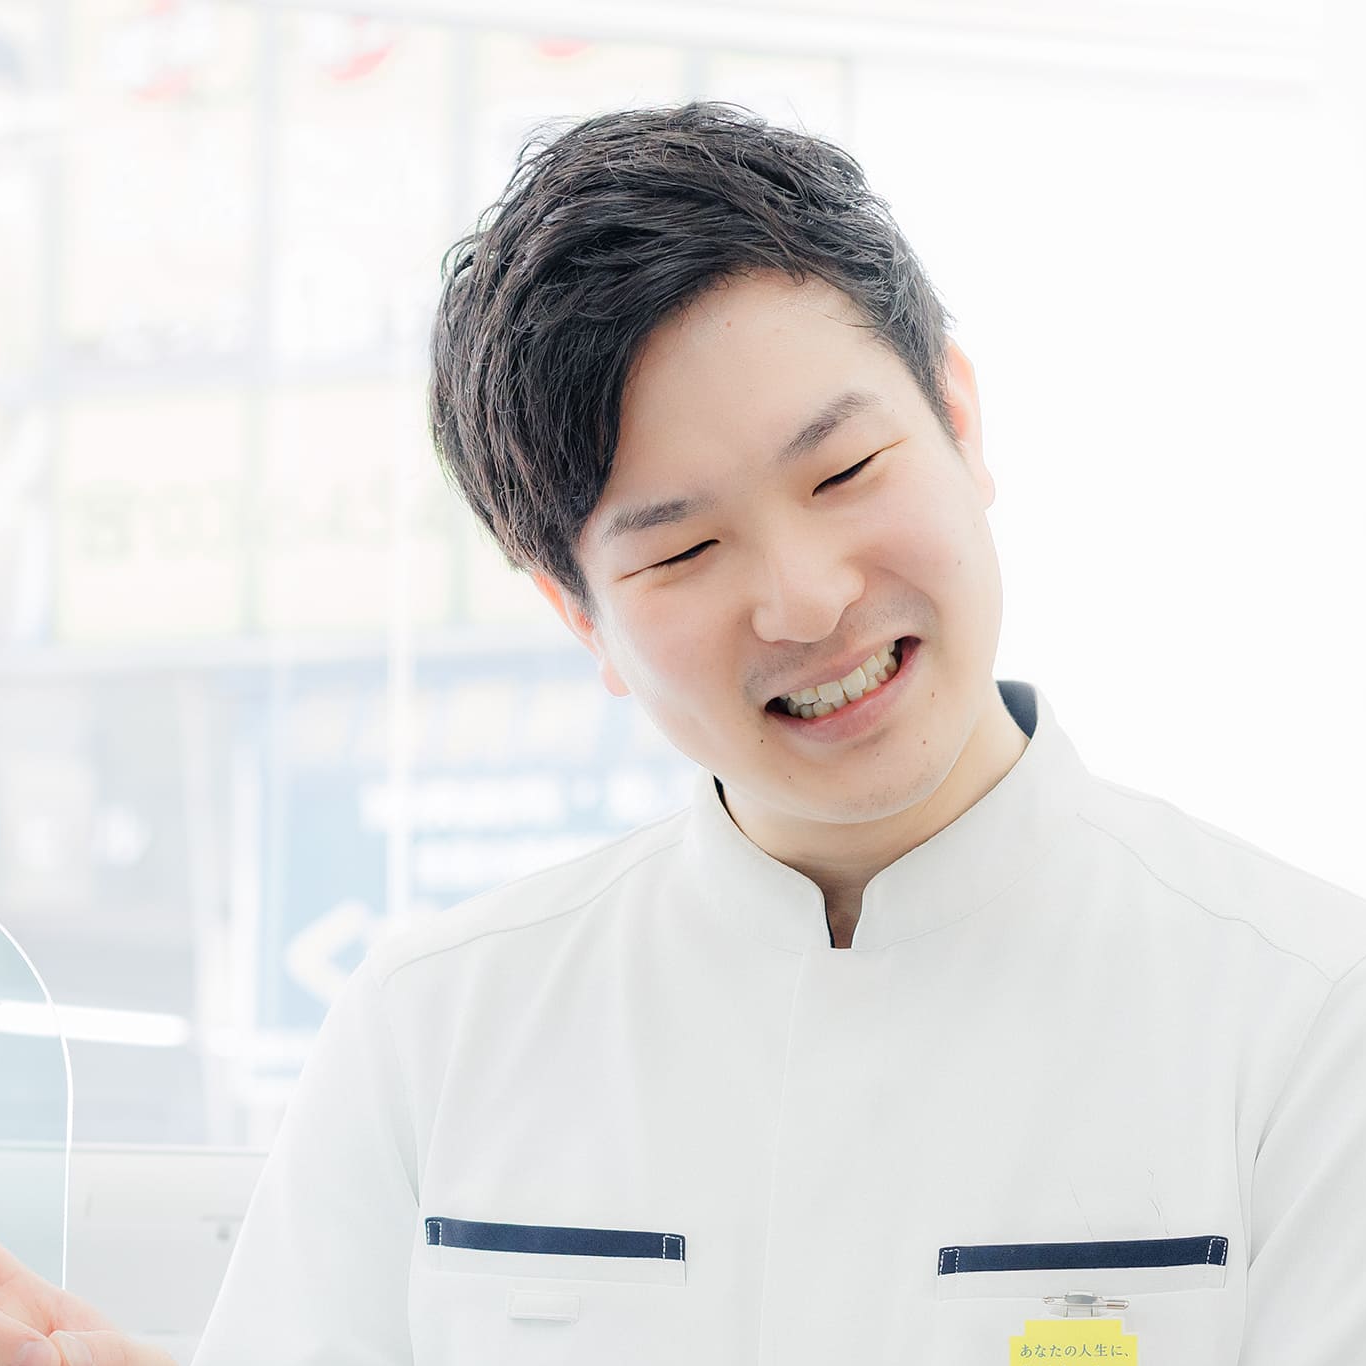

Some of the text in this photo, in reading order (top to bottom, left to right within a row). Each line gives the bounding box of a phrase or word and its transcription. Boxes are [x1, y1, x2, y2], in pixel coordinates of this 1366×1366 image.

[1020, 1344, 1129, 1358] あなたの人生に、
